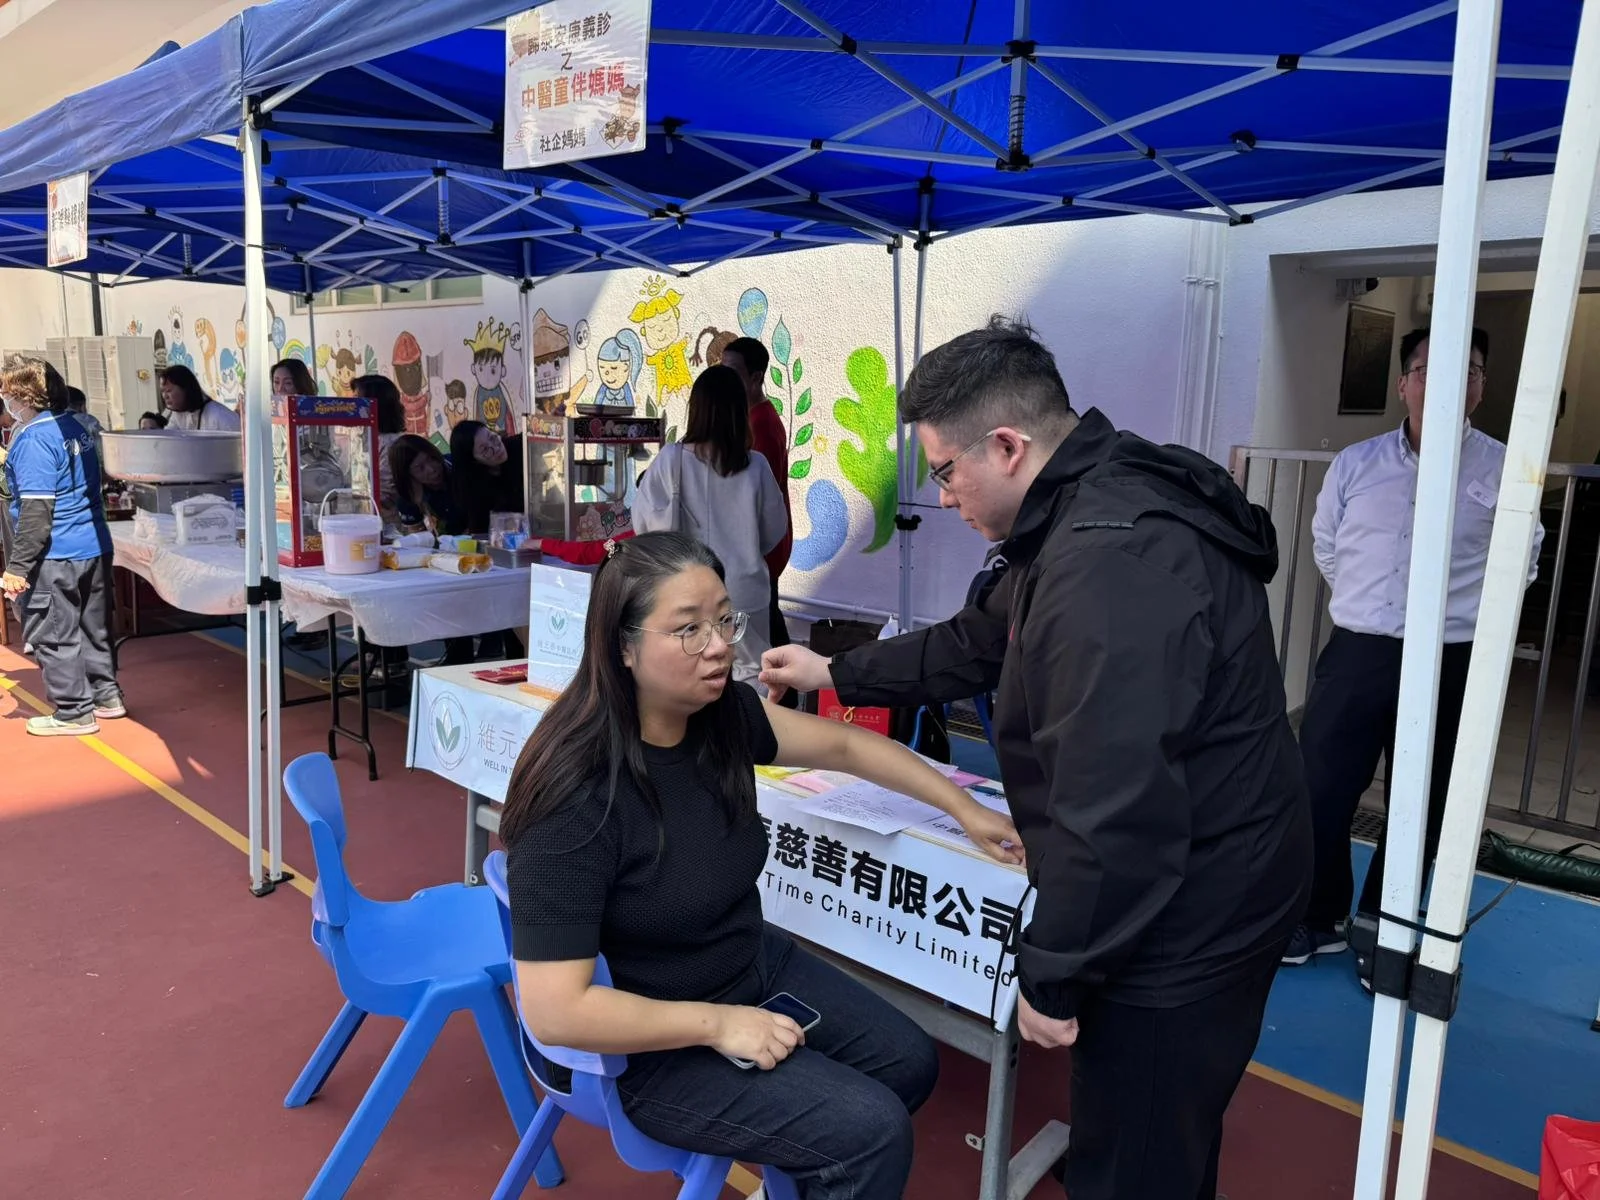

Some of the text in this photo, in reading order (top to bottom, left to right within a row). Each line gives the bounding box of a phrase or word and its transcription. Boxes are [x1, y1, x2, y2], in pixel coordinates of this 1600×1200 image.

[560, 49, 573, 71] 之
[521, 61, 625, 112] 中醫童伴媽媽
[540, 127, 586, 154] 社企媽媽
[483, 757, 500, 771] WELL
[500, 764, 508, 774] IN
[764, 871, 1014, 988] Time Charity Limited
